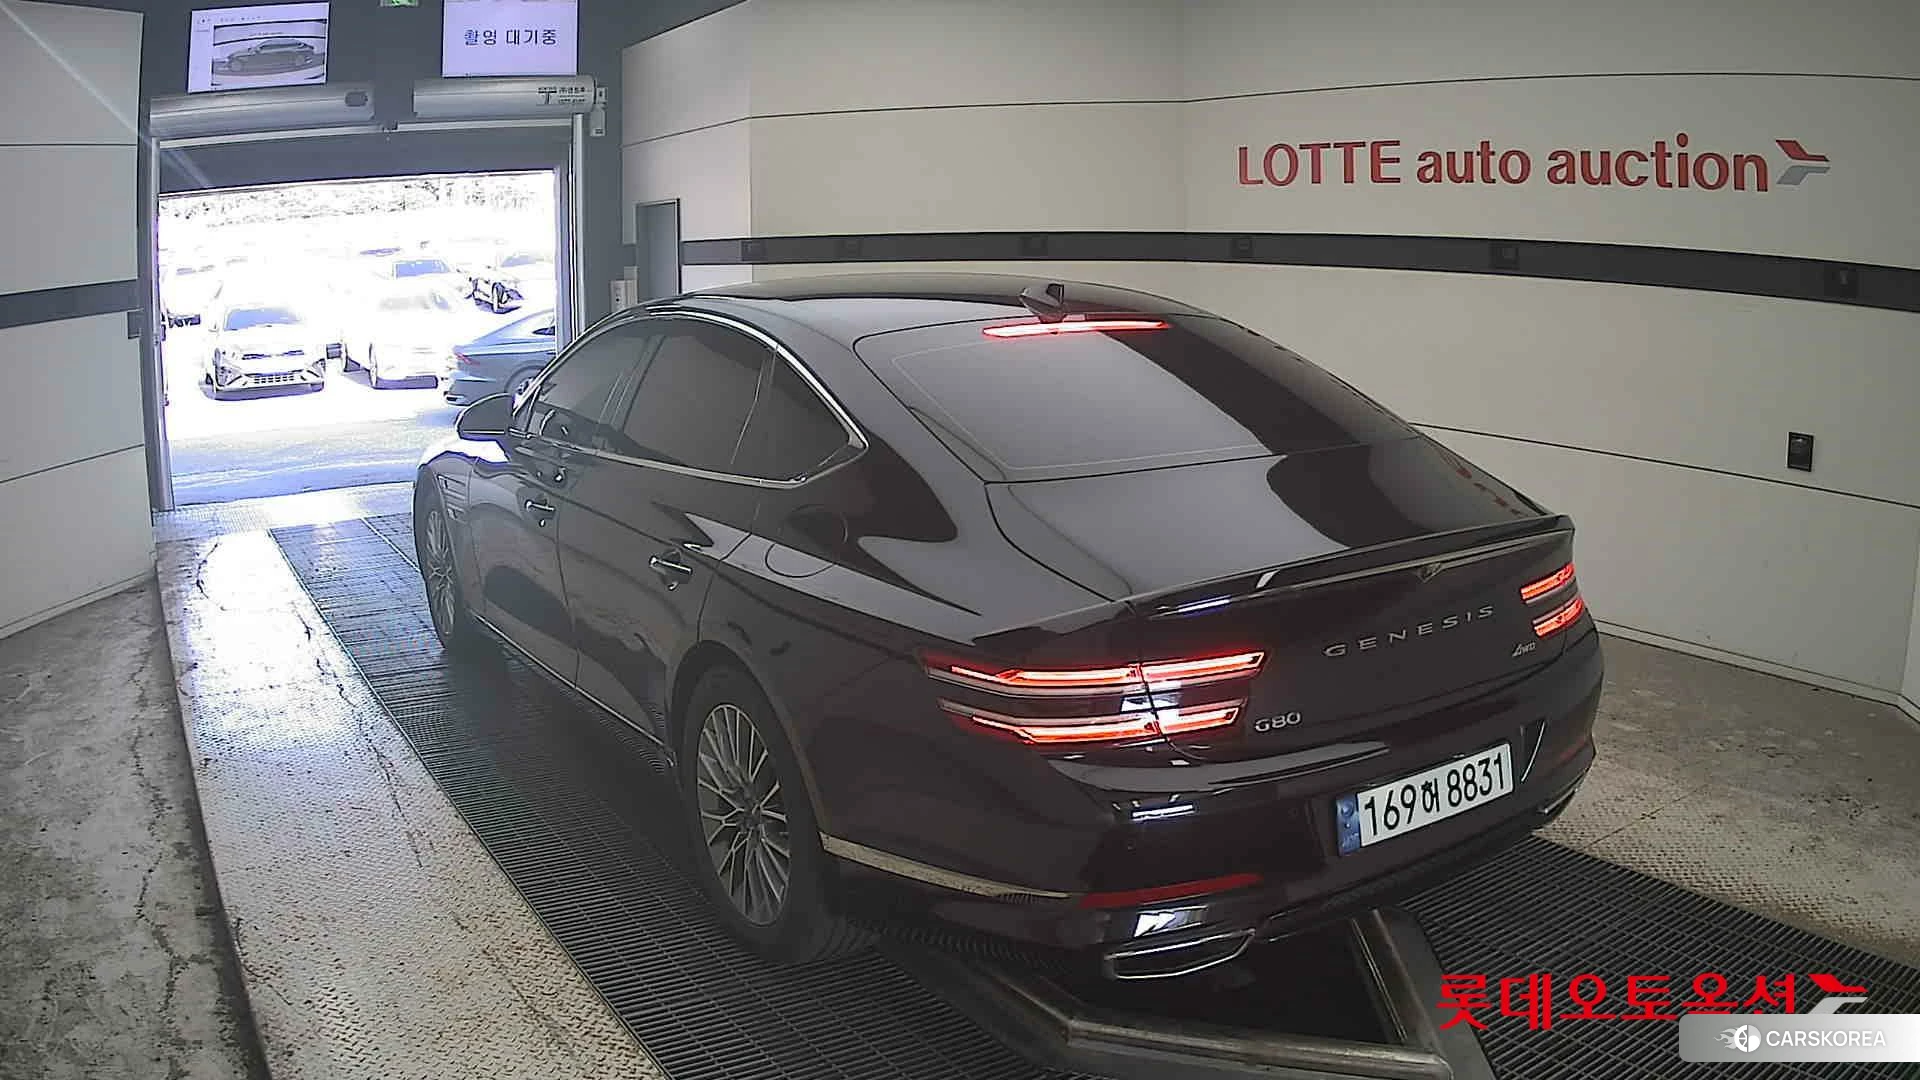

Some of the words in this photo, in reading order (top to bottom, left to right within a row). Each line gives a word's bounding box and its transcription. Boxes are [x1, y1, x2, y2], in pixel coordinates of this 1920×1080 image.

[506, 29, 557, 46] 대기중
[1238, 140, 1401, 186] LOTTE
[1416, 140, 1532, 184] auto
[1546, 133, 1769, 193] auction
[1324, 605, 1494, 657] GENESIS
[1255, 711, 1301, 733] G80
[1364, 778, 1441, 837] 169허
[1447, 752, 1505, 808] 8831
